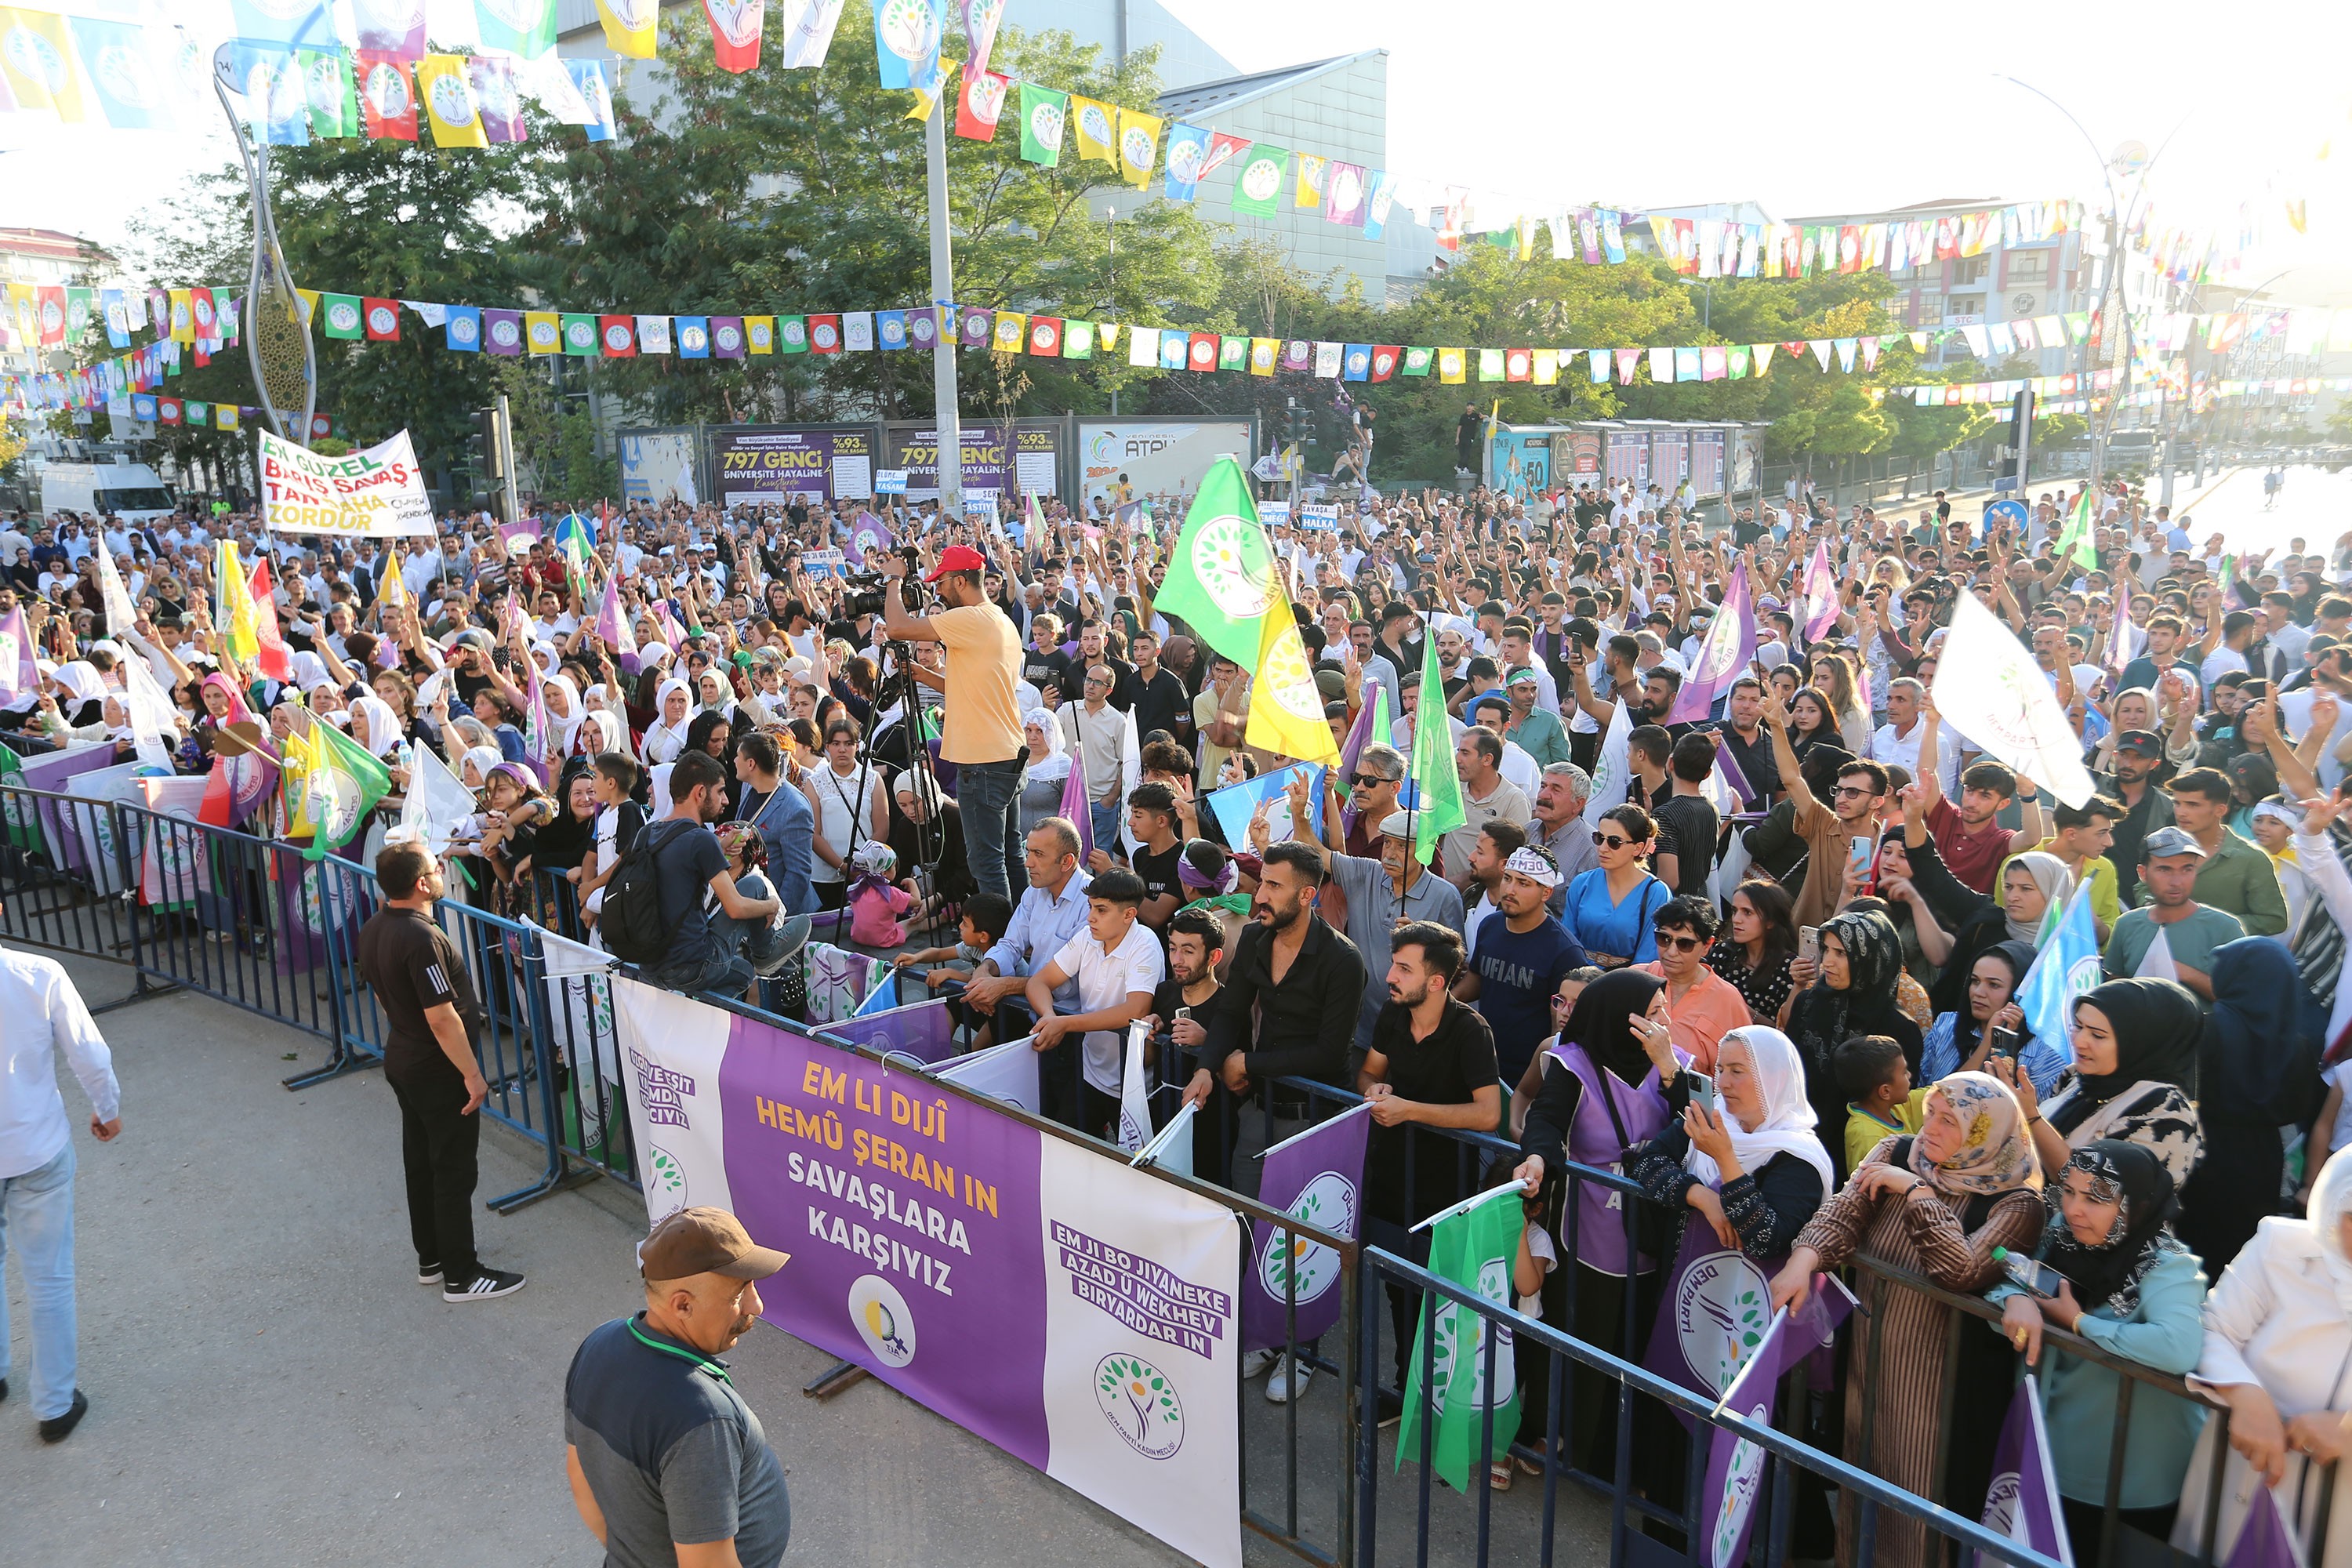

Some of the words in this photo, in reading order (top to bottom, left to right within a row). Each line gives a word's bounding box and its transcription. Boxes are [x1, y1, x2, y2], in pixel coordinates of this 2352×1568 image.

[263, 435, 289, 462] EN
[296, 455, 383, 478] GÜZEL
[265, 457, 329, 497] BARIŞ
[723, 452, 760, 469] 797
[901, 447, 938, 465] 797
[267, 503, 372, 531] ZORDUR
[1303, 519, 1334, 529] HALKA
[802, 1060, 848, 1105] EM
[855, 1078, 881, 1116] LI
[891, 1090, 949, 1143] DIJÎ
[756, 1095, 844, 1151] HEMÛ
[852, 1128, 956, 1200] ŞERAN
[964, 1173, 998, 1219] IN
[787, 1152, 972, 1256] SAVAŞLARA
[808, 1205, 953, 1297] KARŞIYIZ
[1055, 1224, 1082, 1251] EM
[1085, 1239, 1098, 1258] JI
[1104, 1246, 1131, 1270] BO
[1136, 1259, 1225, 1314] JIYANEKE
[1066, 1253, 1116, 1287] AZAD
[1120, 1272, 1132, 1295] Û
[1136, 1283, 1217, 1334] WEKHEV
[1688, 1264, 1717, 1290] DEM
[1077, 1279, 1178, 1344] BIRYARDAR
[1183, 1330, 1205, 1355] IN
[1681, 1290, 1697, 1335] PARTİ
[1106, 1411, 1120, 1427] DEM
[1118, 1426, 1137, 1446] PARTİ
[1137, 1443, 1156, 1456] KADIN
[1156, 1439, 1176, 1456] MECLİSİ
